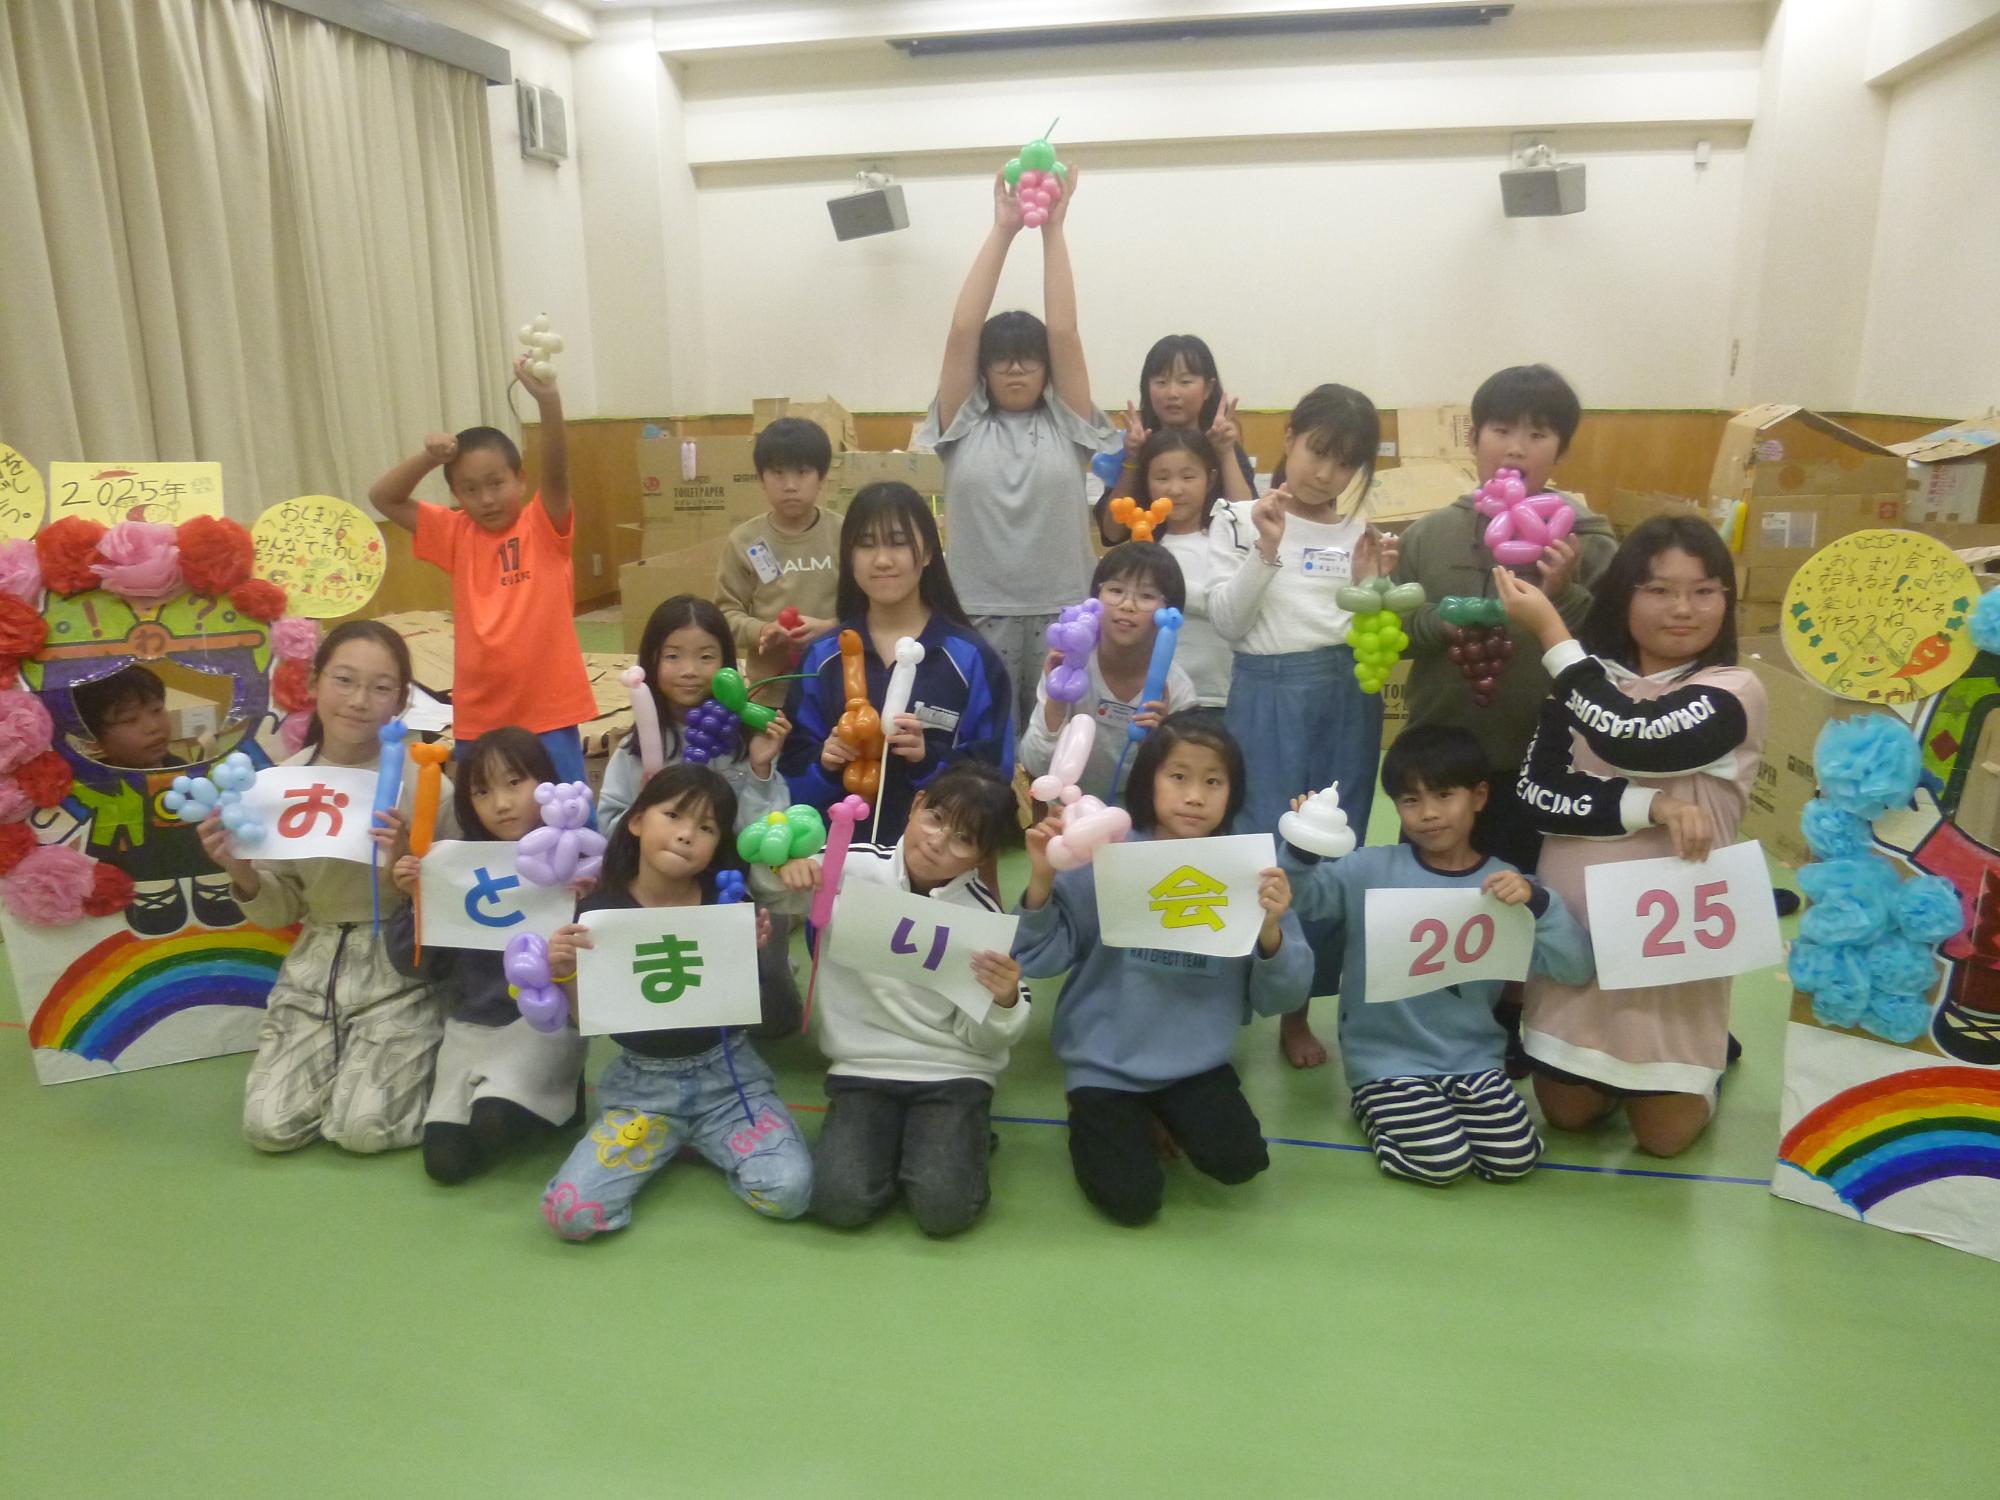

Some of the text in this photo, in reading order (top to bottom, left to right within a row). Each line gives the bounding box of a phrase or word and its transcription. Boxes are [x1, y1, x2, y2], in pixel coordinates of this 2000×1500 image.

[61, 478, 188, 507] 2025年
[498, 537, 520, 573] 17
[783, 554, 832, 575] ALM
[1384, 684, 1404, 699] TOI
[277, 783, 349, 839] お
[464, 866, 527, 928] と
[1147, 864, 1229, 932] 会
[1635, 880, 1736, 958] 25
[632, 933, 704, 1004] ま
[890, 916, 950, 972] り
[1408, 913, 1495, 977] 20
